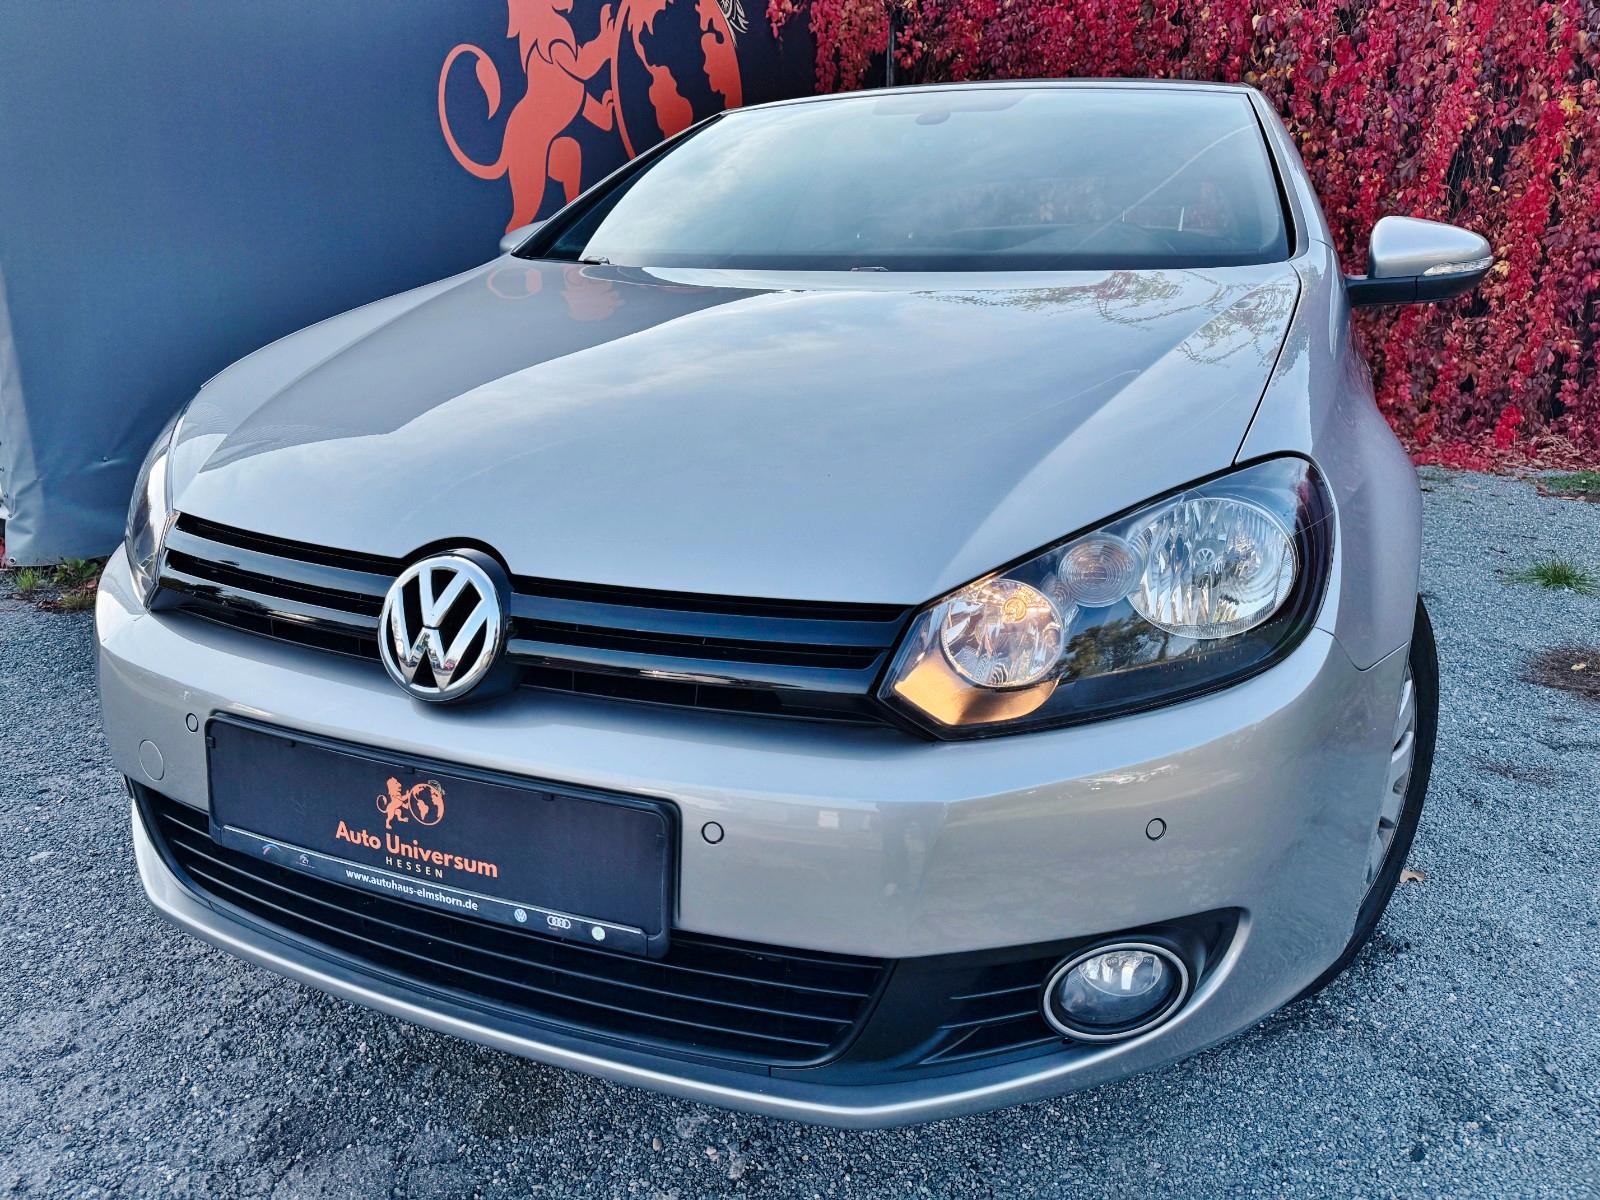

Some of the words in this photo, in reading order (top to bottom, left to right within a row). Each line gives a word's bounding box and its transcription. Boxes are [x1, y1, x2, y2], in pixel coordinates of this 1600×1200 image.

[336, 820, 381, 850] Auto
[386, 833, 498, 878] Universum
[386, 856, 444, 879] HESSEN
[345, 869, 479, 911] www.autohaus-elmshorn.de
